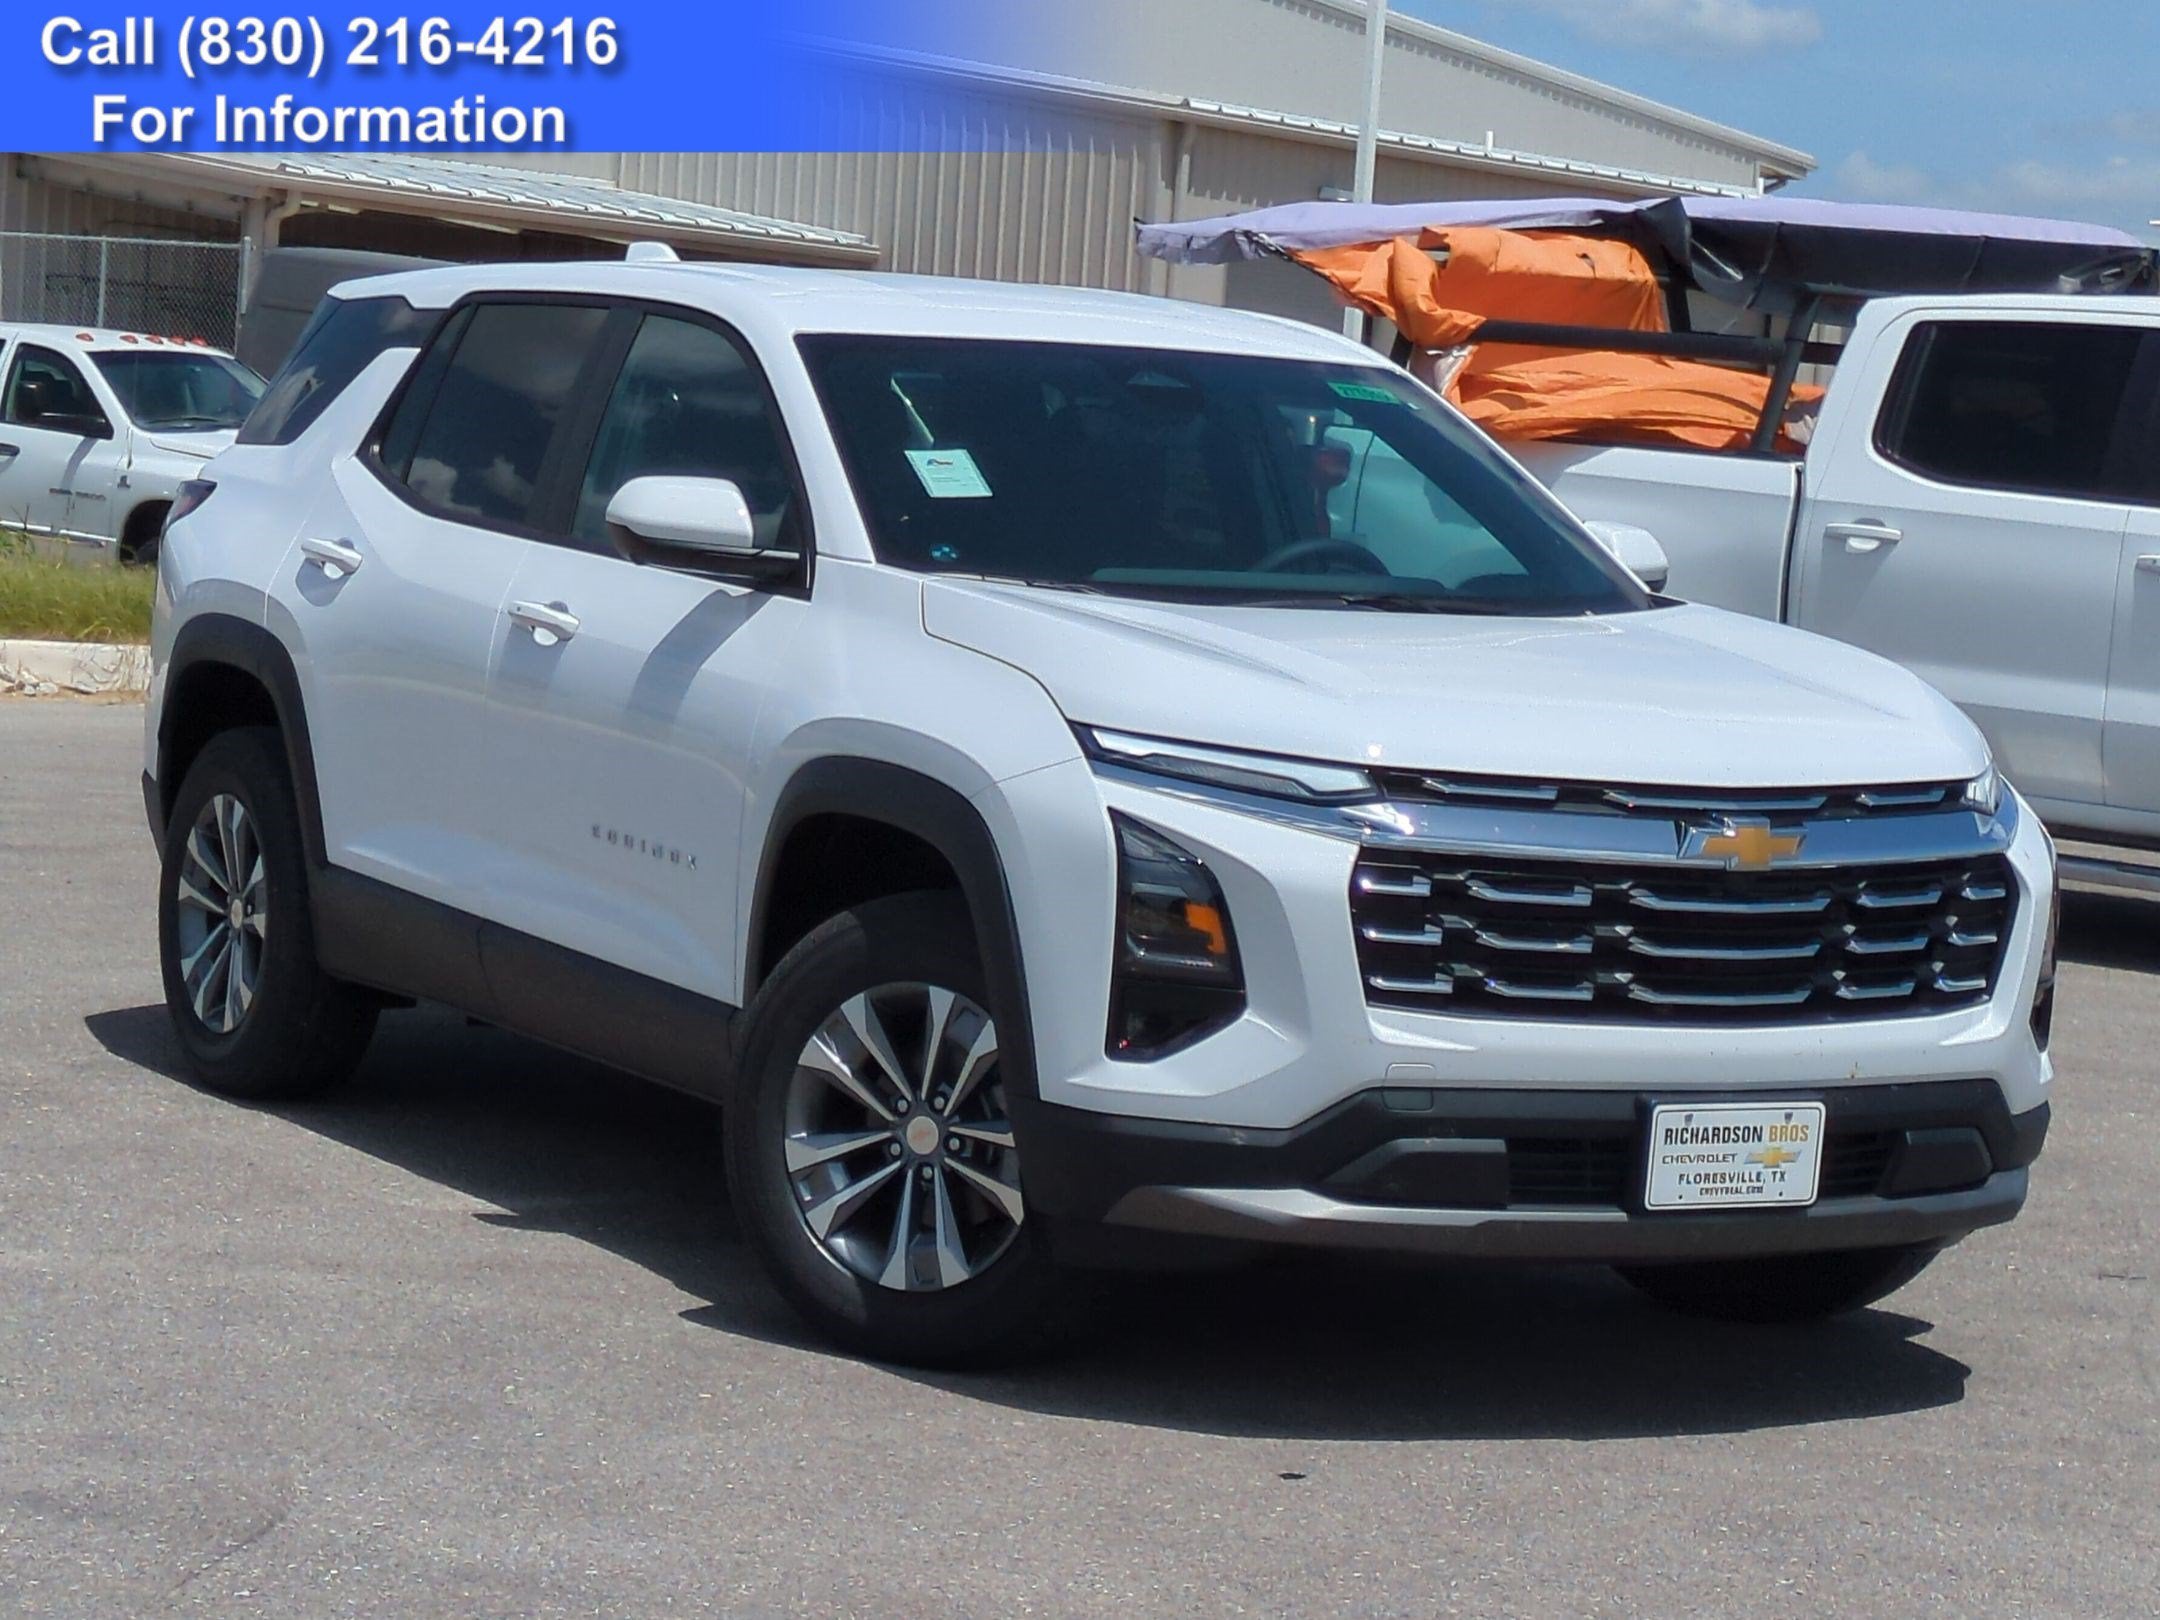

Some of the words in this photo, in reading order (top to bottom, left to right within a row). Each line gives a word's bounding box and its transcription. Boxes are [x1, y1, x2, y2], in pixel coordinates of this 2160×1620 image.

[1664, 1125, 1763, 1145] RICHARDSON
[1768, 1124, 1809, 1143] BROS
[1661, 1153, 1738, 1165] CHEVROLET
[1678, 1171, 1766, 1186] FLORESVILLE,
[1770, 1171, 1786, 1182] TX
